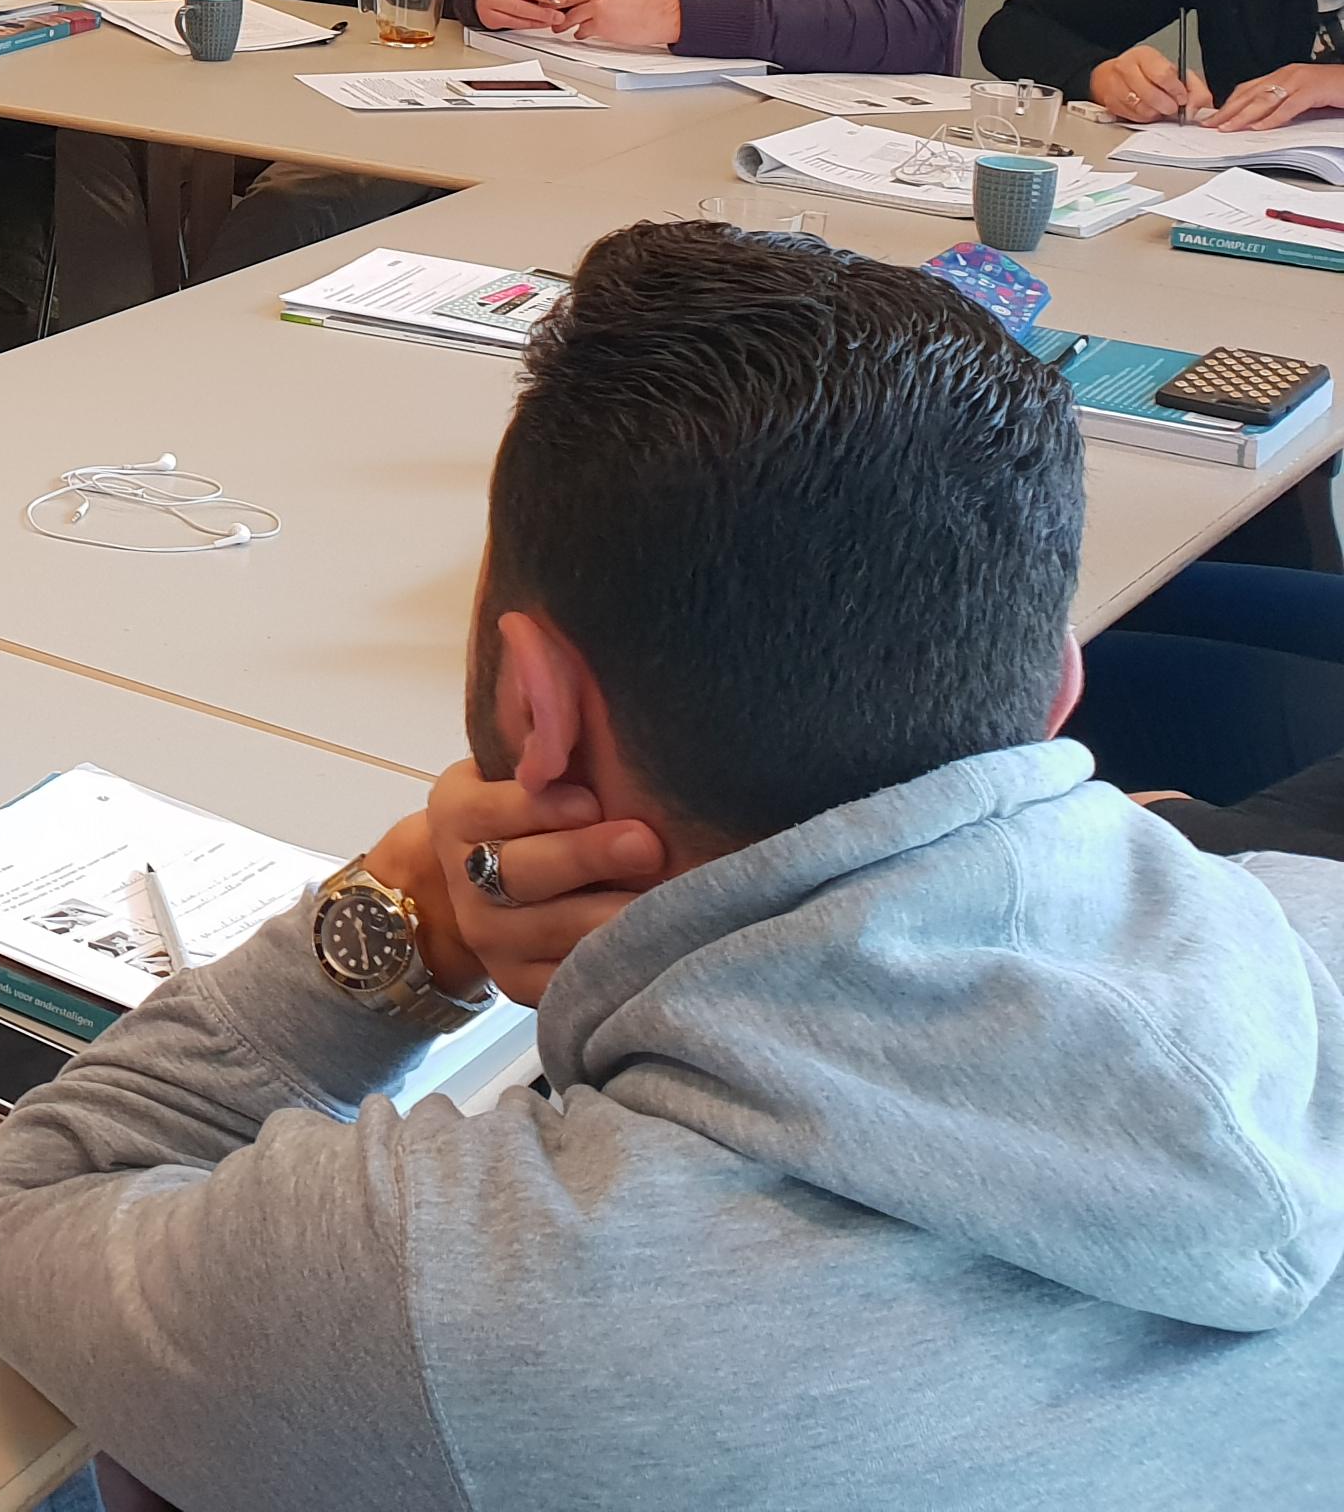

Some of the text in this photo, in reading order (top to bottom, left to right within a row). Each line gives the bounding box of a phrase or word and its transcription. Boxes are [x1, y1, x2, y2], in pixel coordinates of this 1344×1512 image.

[1178, 233, 1265, 253] TAALCOMPLEET
[13, 989, 34, 1005] voor
[34, 998, 94, 1028] anderstaligen
